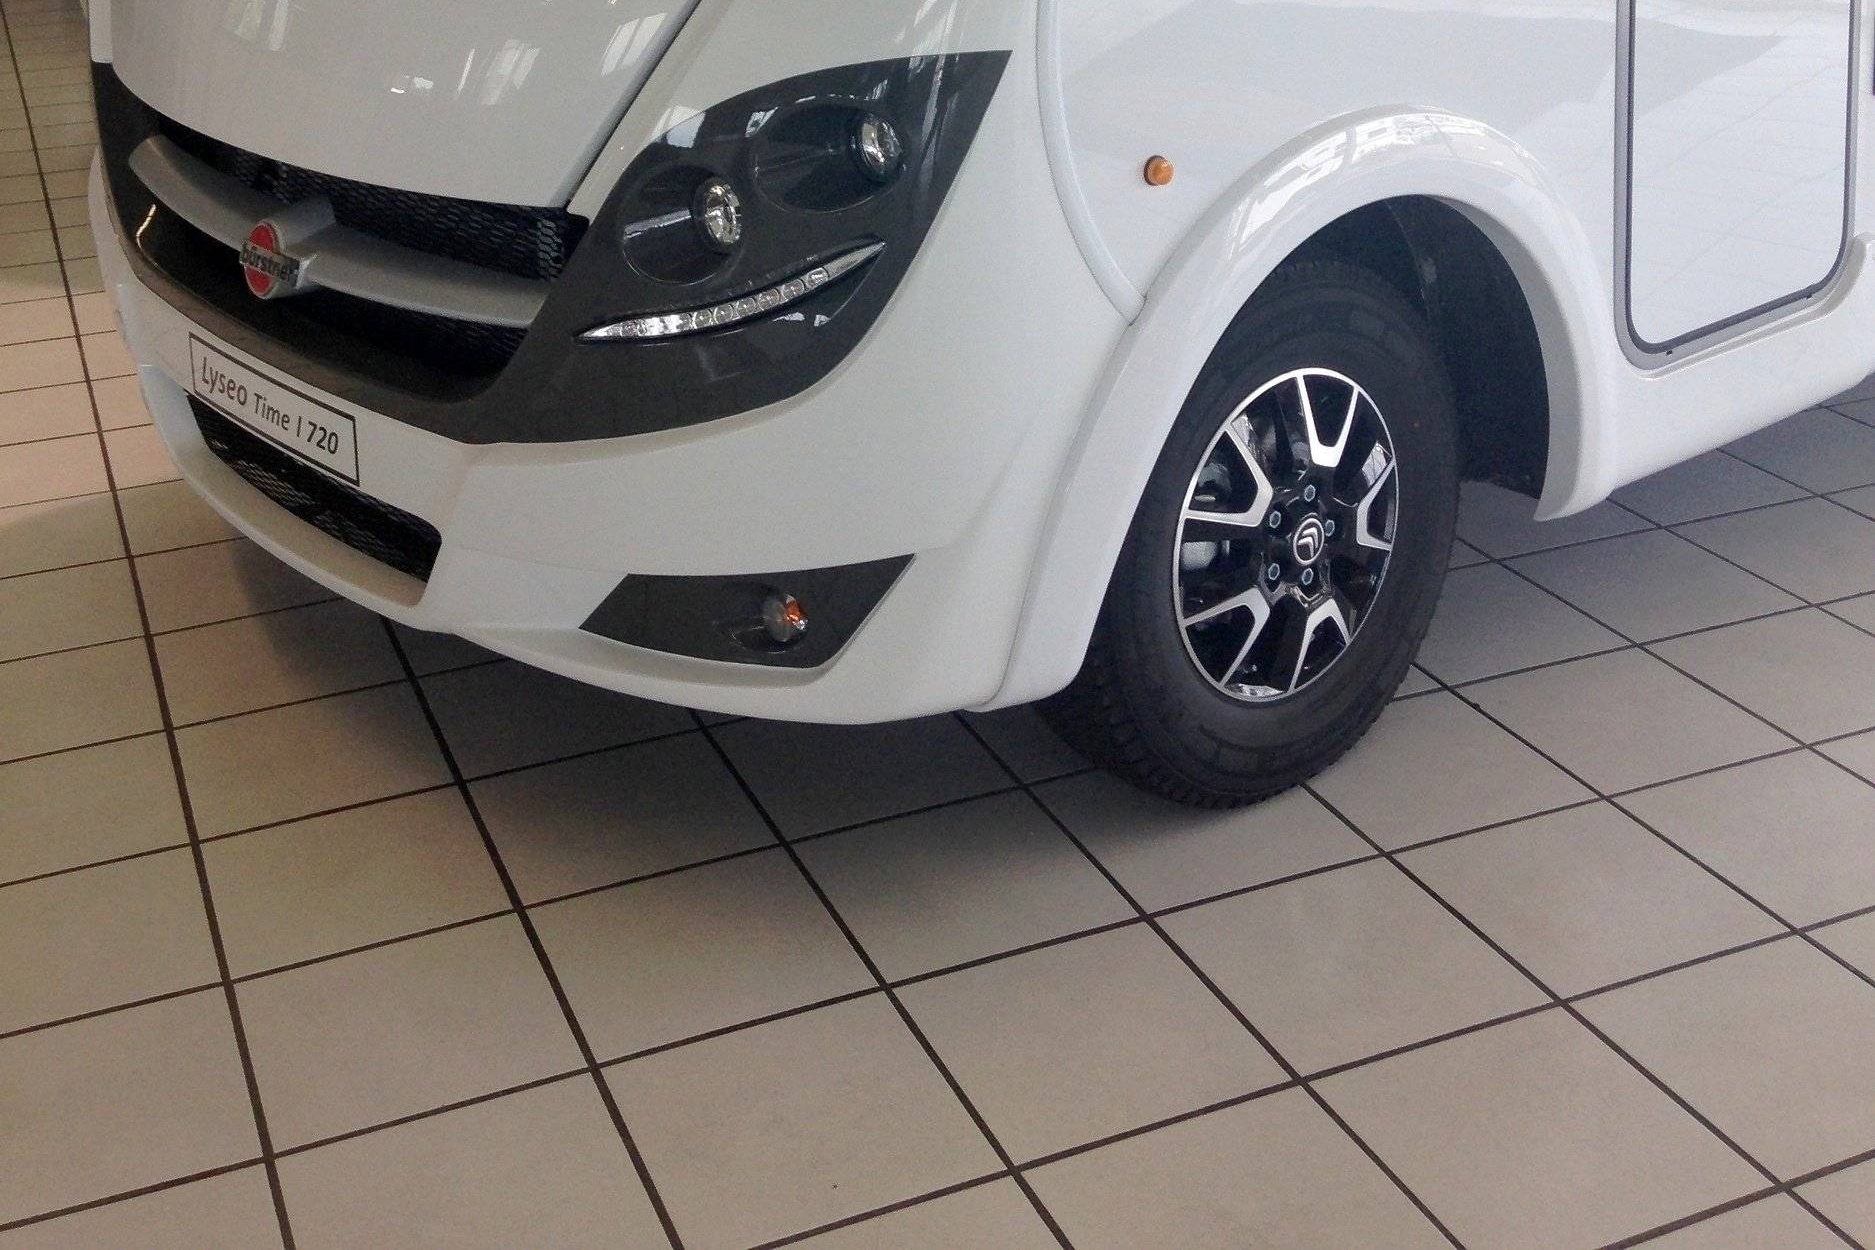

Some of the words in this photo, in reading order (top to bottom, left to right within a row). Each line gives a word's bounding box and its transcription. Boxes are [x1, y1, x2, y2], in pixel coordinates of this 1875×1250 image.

[201, 357, 248, 406] Lyseo
[253, 392, 290, 431] Time
[307, 421, 339, 455] 720
